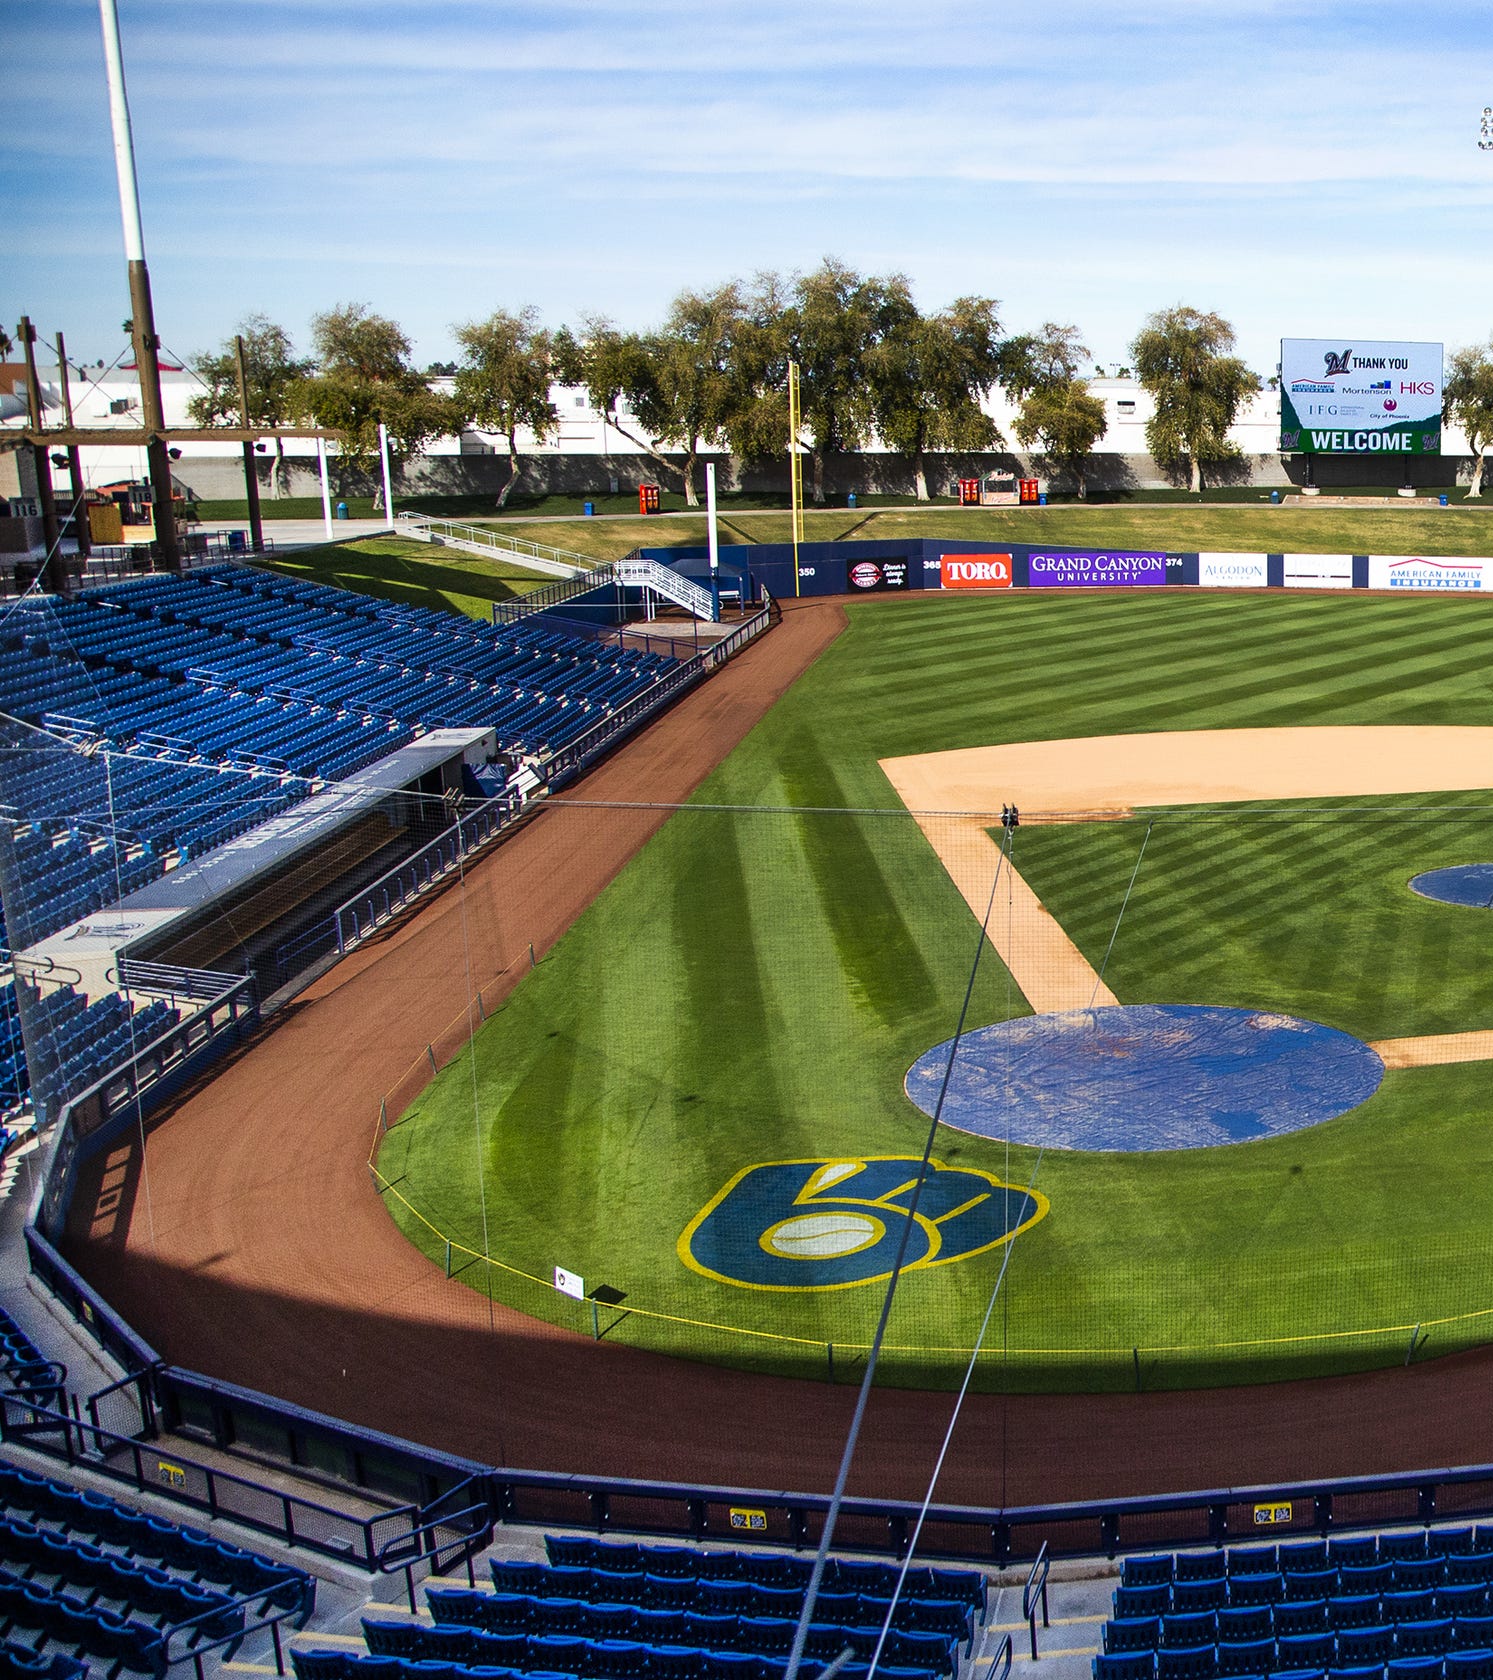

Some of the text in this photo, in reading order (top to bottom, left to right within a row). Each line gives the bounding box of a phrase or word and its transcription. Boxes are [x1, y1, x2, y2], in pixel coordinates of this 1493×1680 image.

[1352, 357, 1408, 370] THANK YOU
[1342, 387, 1392, 395] Mortenson
[1400, 381, 1435, 395] HKS
[1311, 431, 1413, 450] WELCOME
[15, 504, 38, 517] 116
[923, 560, 942, 570] 365
[1032, 555, 1163, 572] GRAND CANYON
[1165, 558, 1183, 567] 374
[798, 567, 815, 577] 350
[947, 561, 1008, 581] TORO
[1057, 572, 1138, 581] UNIVERSITY
[1205, 565, 1263, 577] ALGODON
[1390, 570, 1482, 579] AMERICAN FAMILY
[1396, 578, 1476, 588] INSURANCE
